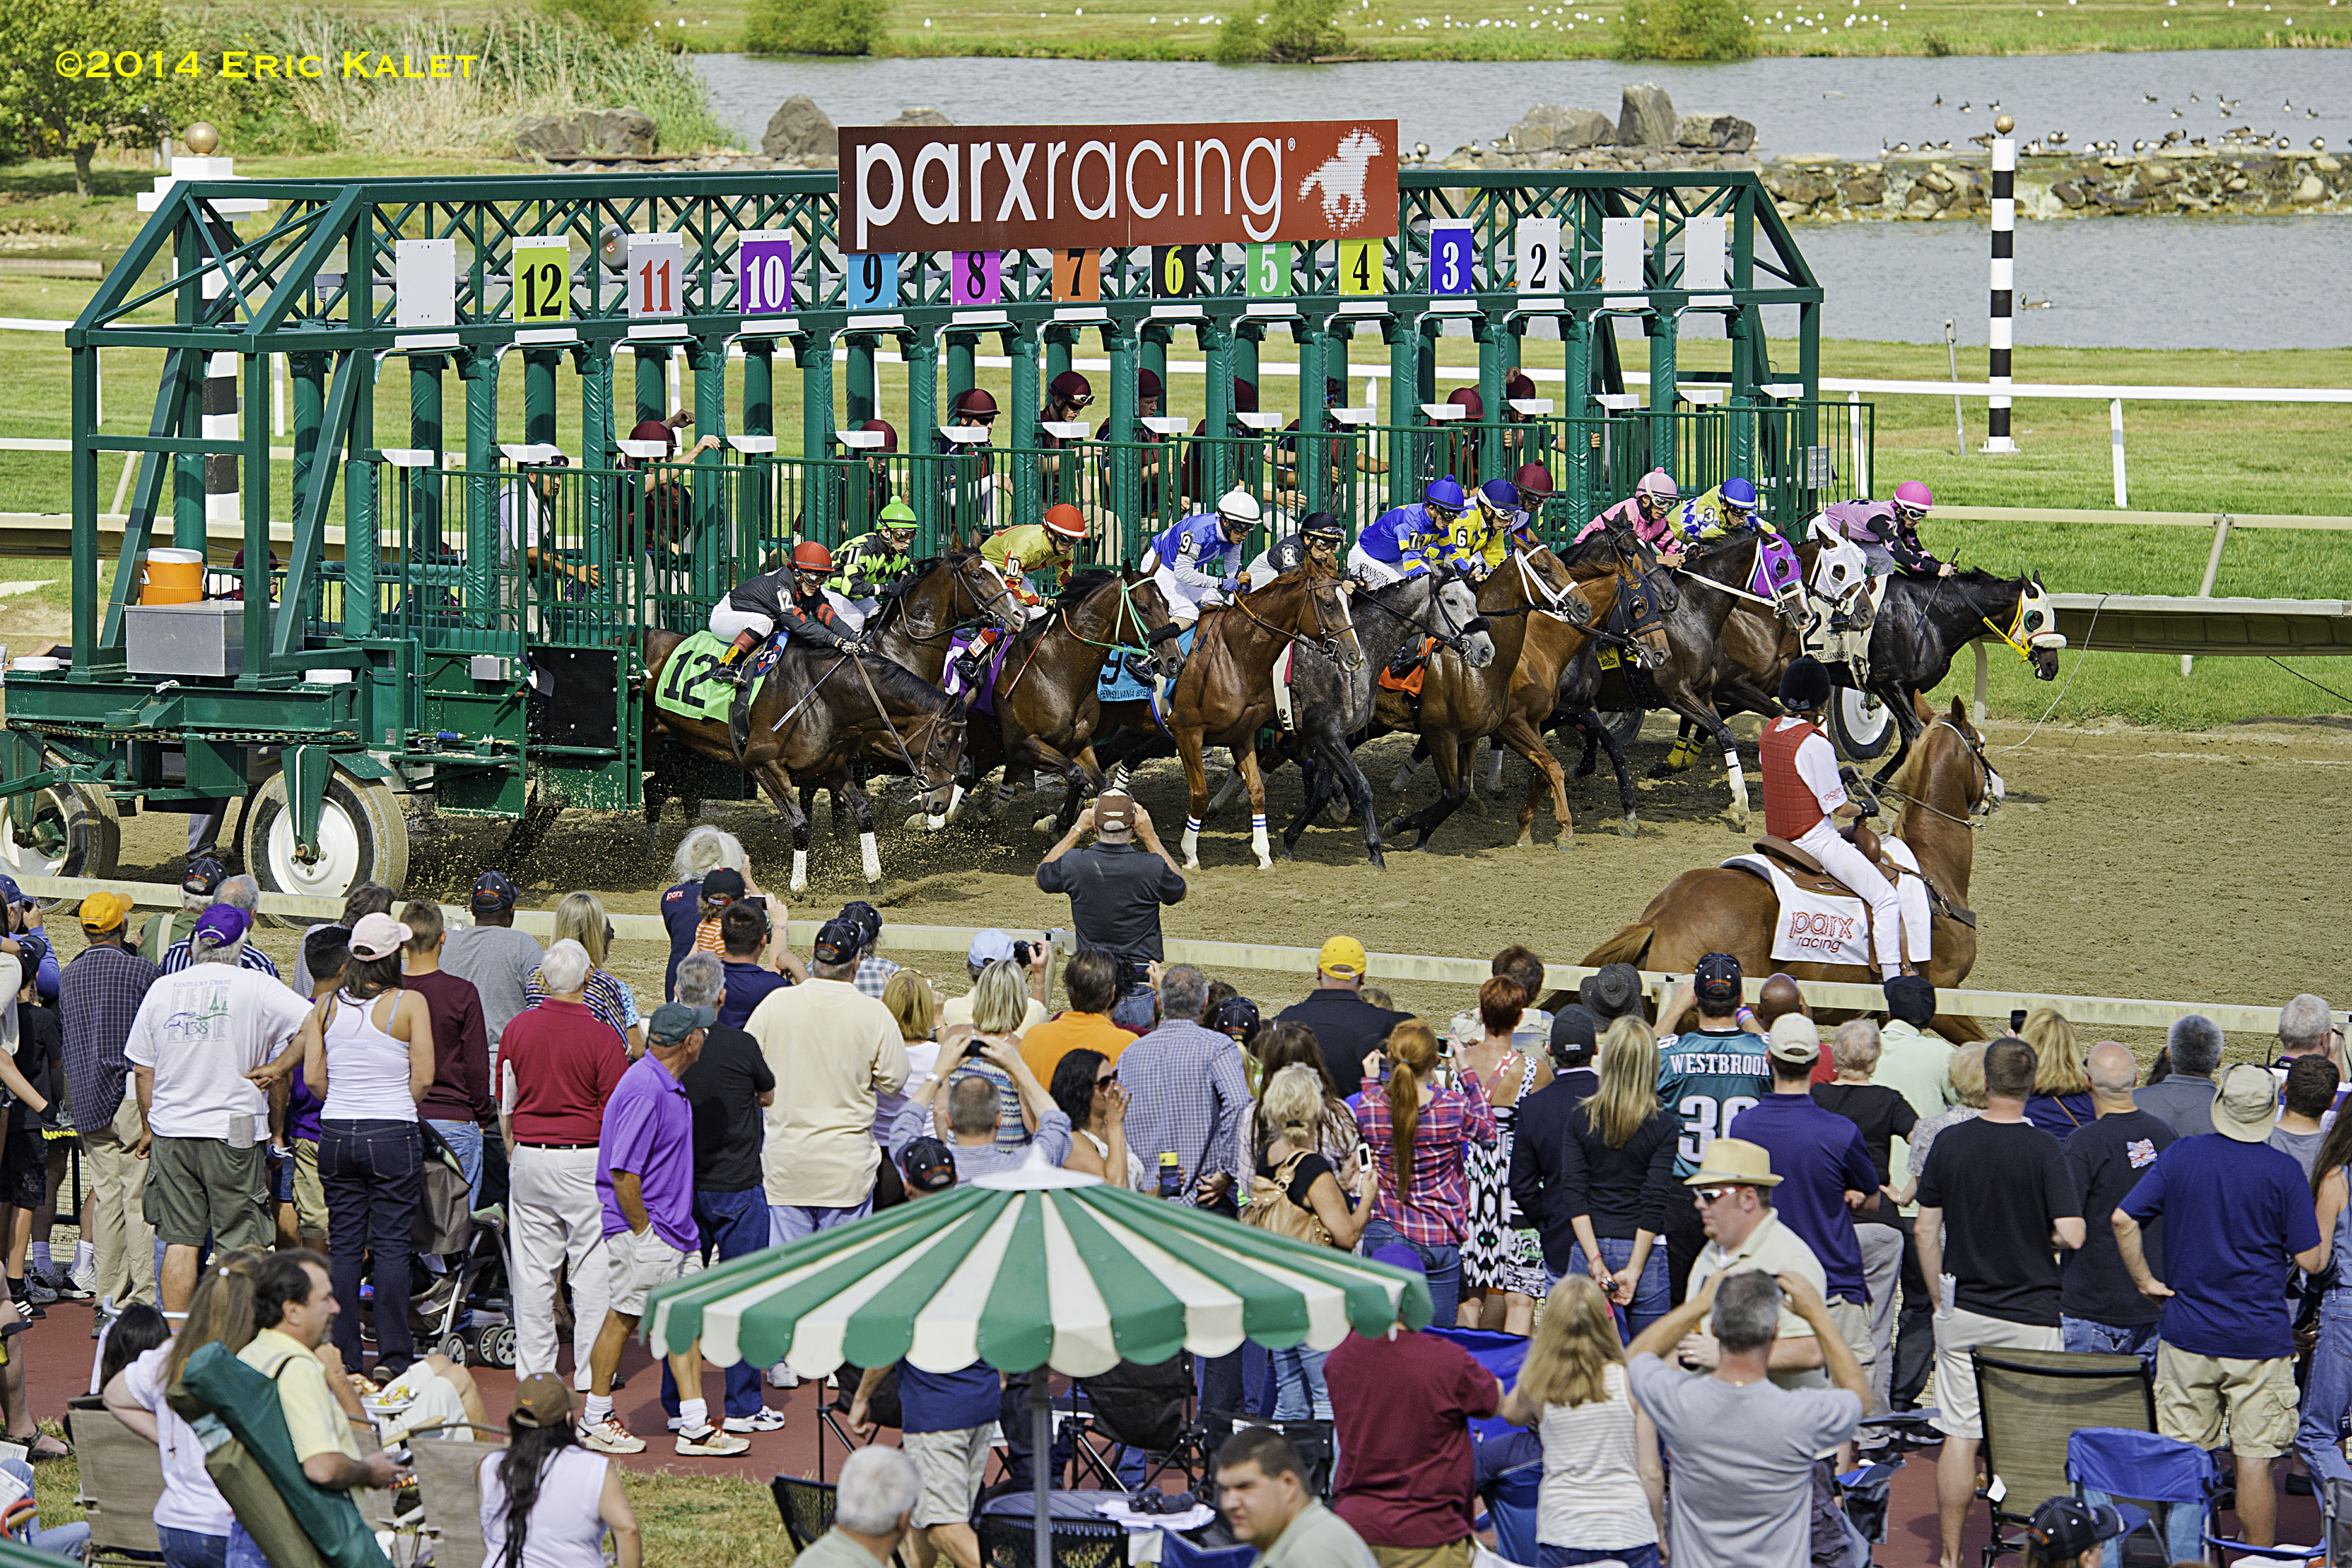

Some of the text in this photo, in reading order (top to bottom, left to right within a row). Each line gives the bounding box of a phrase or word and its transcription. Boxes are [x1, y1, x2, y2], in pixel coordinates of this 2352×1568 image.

[639, 259, 670, 312] 11
[746, 255, 785, 308] 10
[862, 253, 883, 304] 9
[967, 250, 986, 299] 8
[1067, 248, 1085, 297] 7
[1164, 245, 1184, 295] 6
[1260, 243, 1279, 293] 5
[1352, 243, 1371, 291] 4
[1443, 241, 1460, 290] 3
[1531, 242, 1547, 289] 2
[521, 263, 563, 317] 12
[1705, 508, 1714, 522] 3
[1180, 534, 1192, 554] 9
[1283, 547, 1295, 566] 8
[1409, 532, 1418, 549] 7
[1457, 530, 1467, 547] 6
[1006, 558, 1020, 577] 10
[776, 589, 796, 612] 12
[1803, 611, 1824, 651] 2
[662, 649, 721, 710] 12
[1135, 687, 1151, 697] BRED
[1788, 911, 1855, 939] parx
[1797, 937, 1845, 953] racing
[184, 1021, 208, 1036] 138
[1669, 1053, 1771, 1077] WESTBROOK
